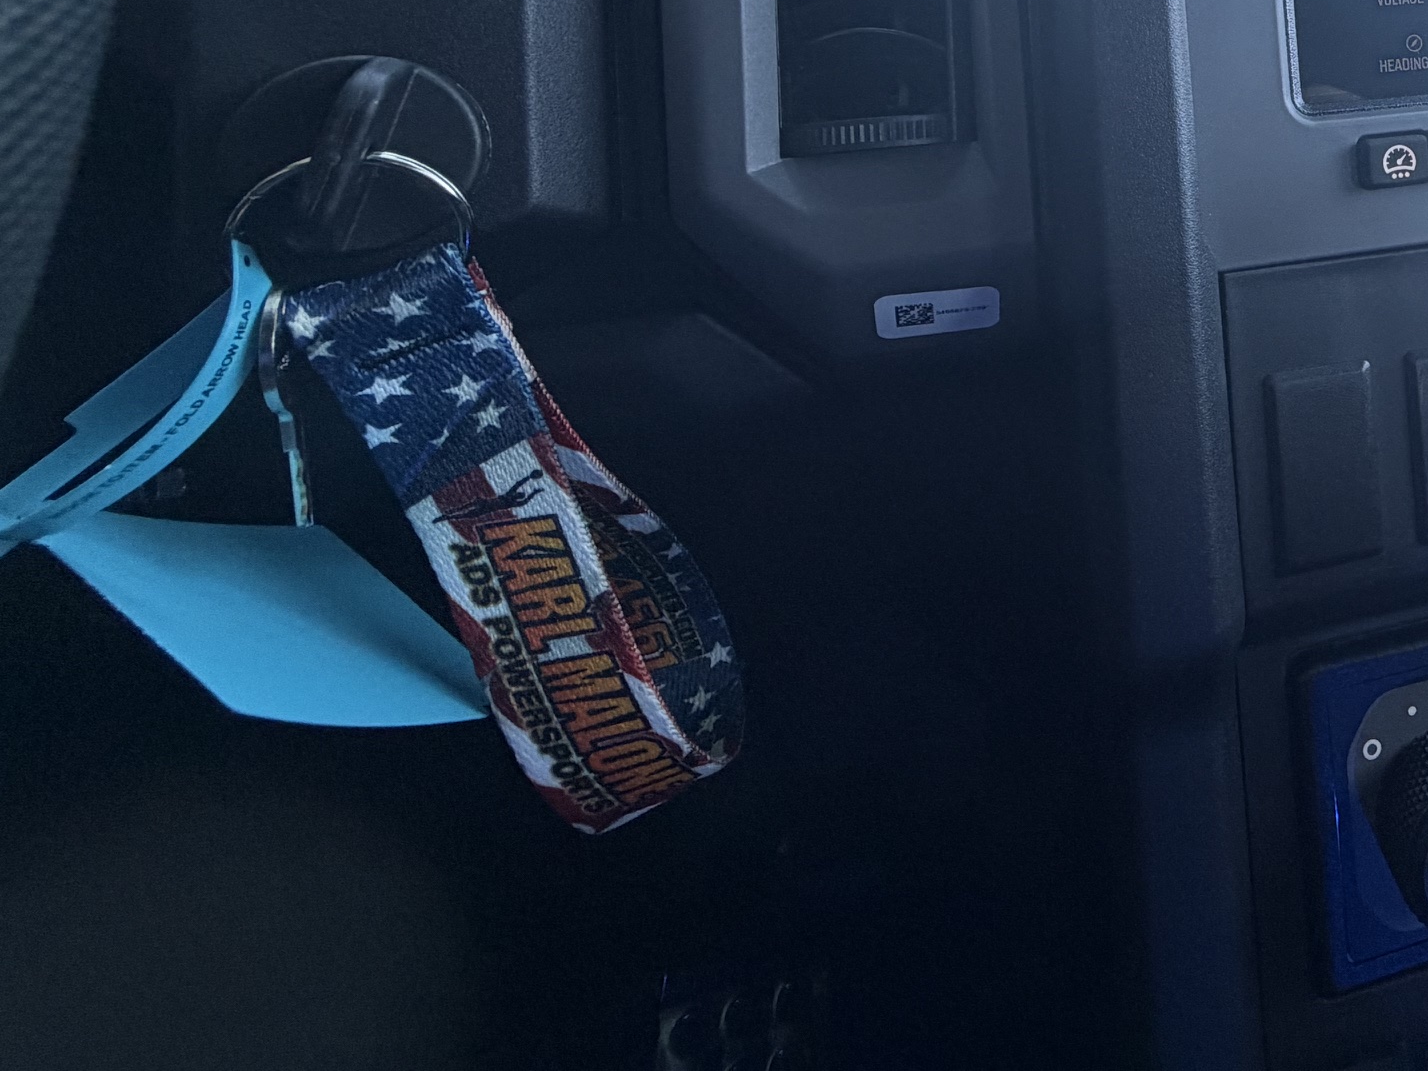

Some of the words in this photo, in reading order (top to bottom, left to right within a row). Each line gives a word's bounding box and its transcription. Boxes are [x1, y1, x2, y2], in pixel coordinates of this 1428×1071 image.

[1379, 57, 1428, 72] HEADING
[165, 399, 204, 436] FOLD
[202, 344, 239, 399] ARROW
[234, 299, 252, 340] HEAD
[478, 517, 598, 651] KARL
[451, 542, 501, 607] ADS
[483, 617, 615, 814] POWERSPORTS
